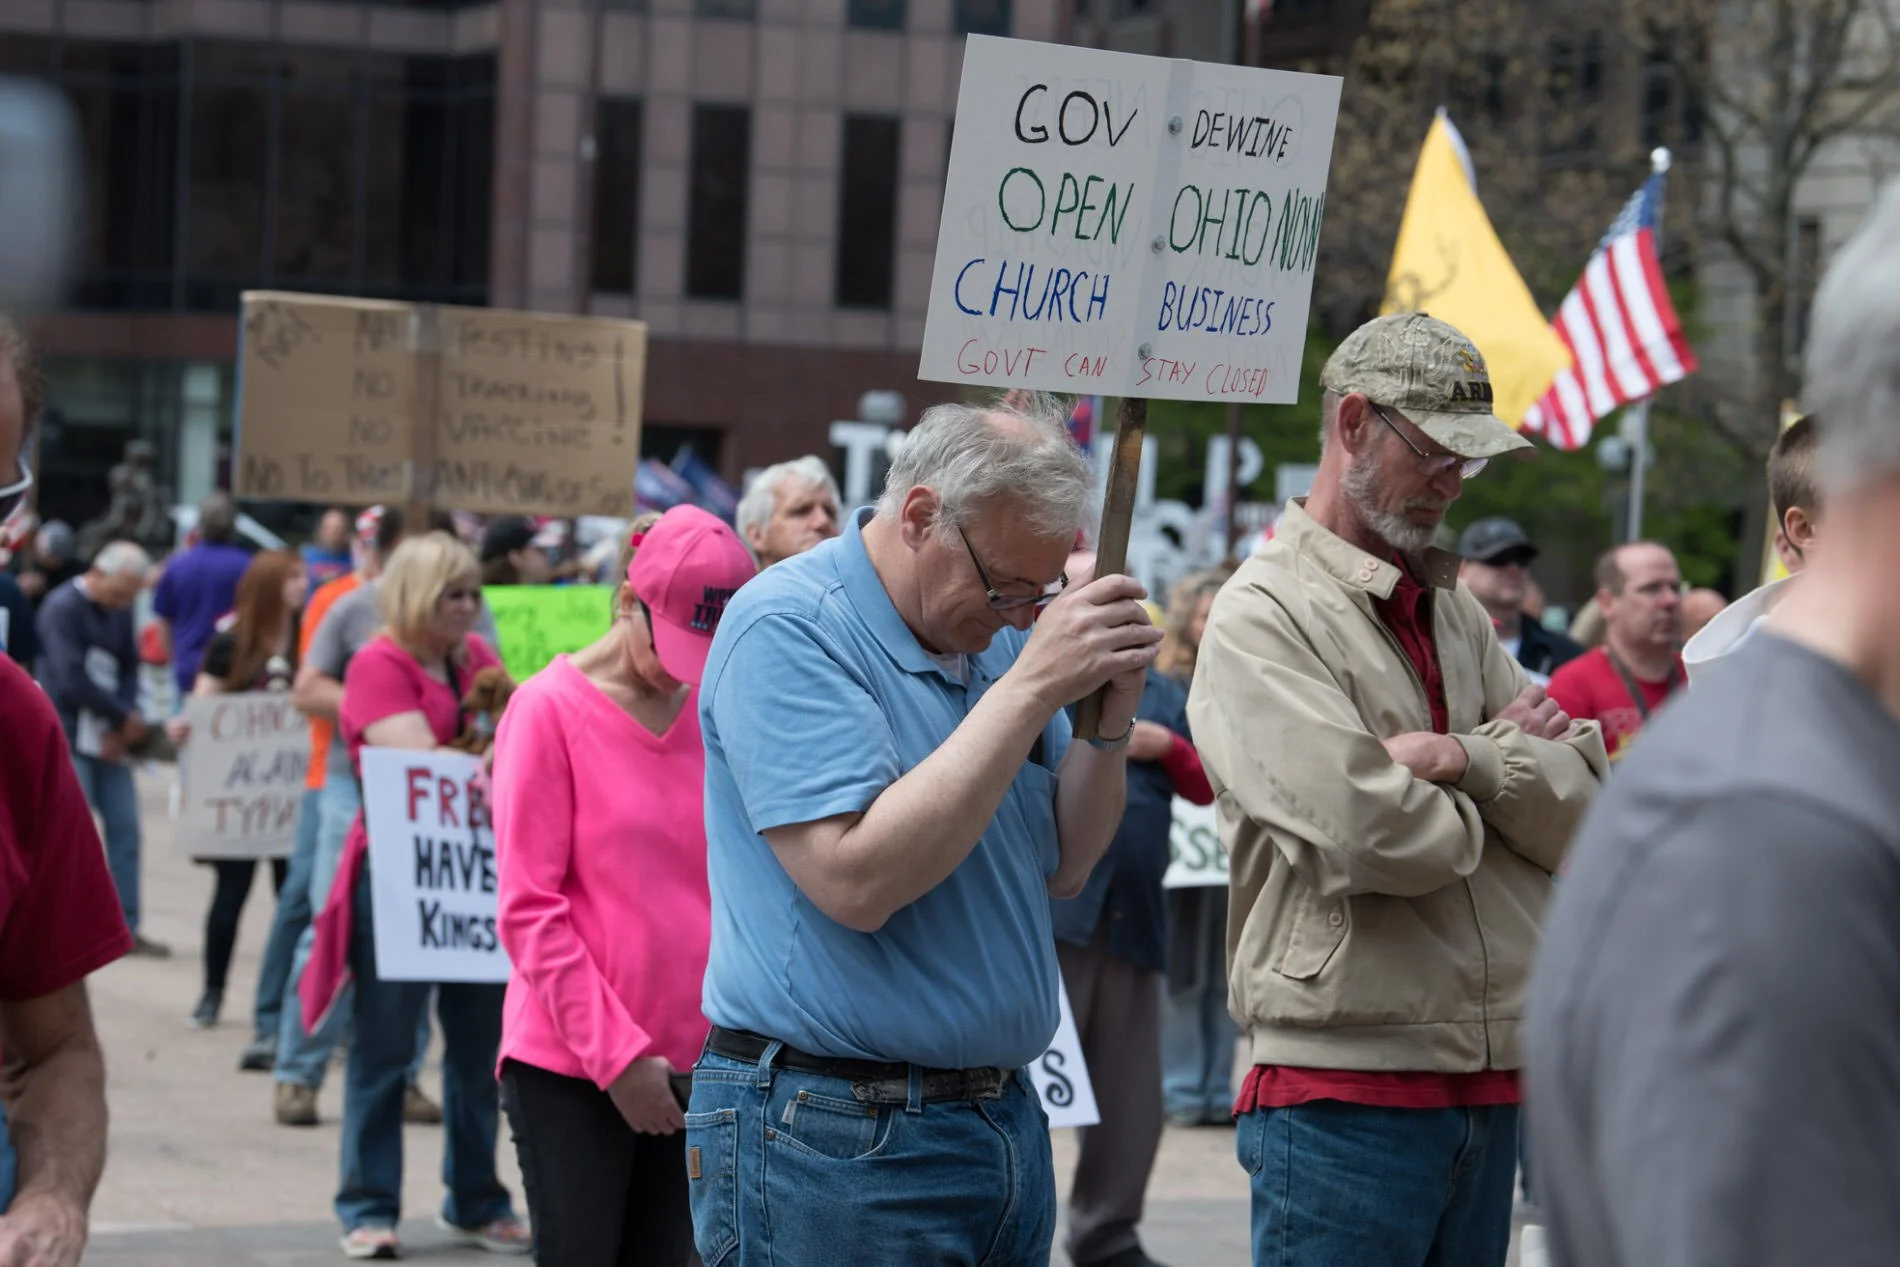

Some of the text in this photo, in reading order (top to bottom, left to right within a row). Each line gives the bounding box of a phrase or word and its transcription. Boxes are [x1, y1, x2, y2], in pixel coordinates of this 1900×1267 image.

[1015, 84, 1138, 146] GOV
[1191, 109, 1294, 163] DEWINE
[999, 167, 1134, 244] OPEN
[1169, 185, 1272, 266] OHIO
[1270, 187, 1326, 275] NOW
[954, 258, 1275, 336] CHURCH BUSINESS
[957, 338, 1048, 377] GOVT
[1065, 352, 1108, 378] CAN
[1135, 356, 1197, 386] STAY
[1205, 363, 1270, 396] CLOSED
[406, 766, 494, 829] FRE
[414, 834, 497, 892] HAVE
[418, 898, 498, 953] KINGS
